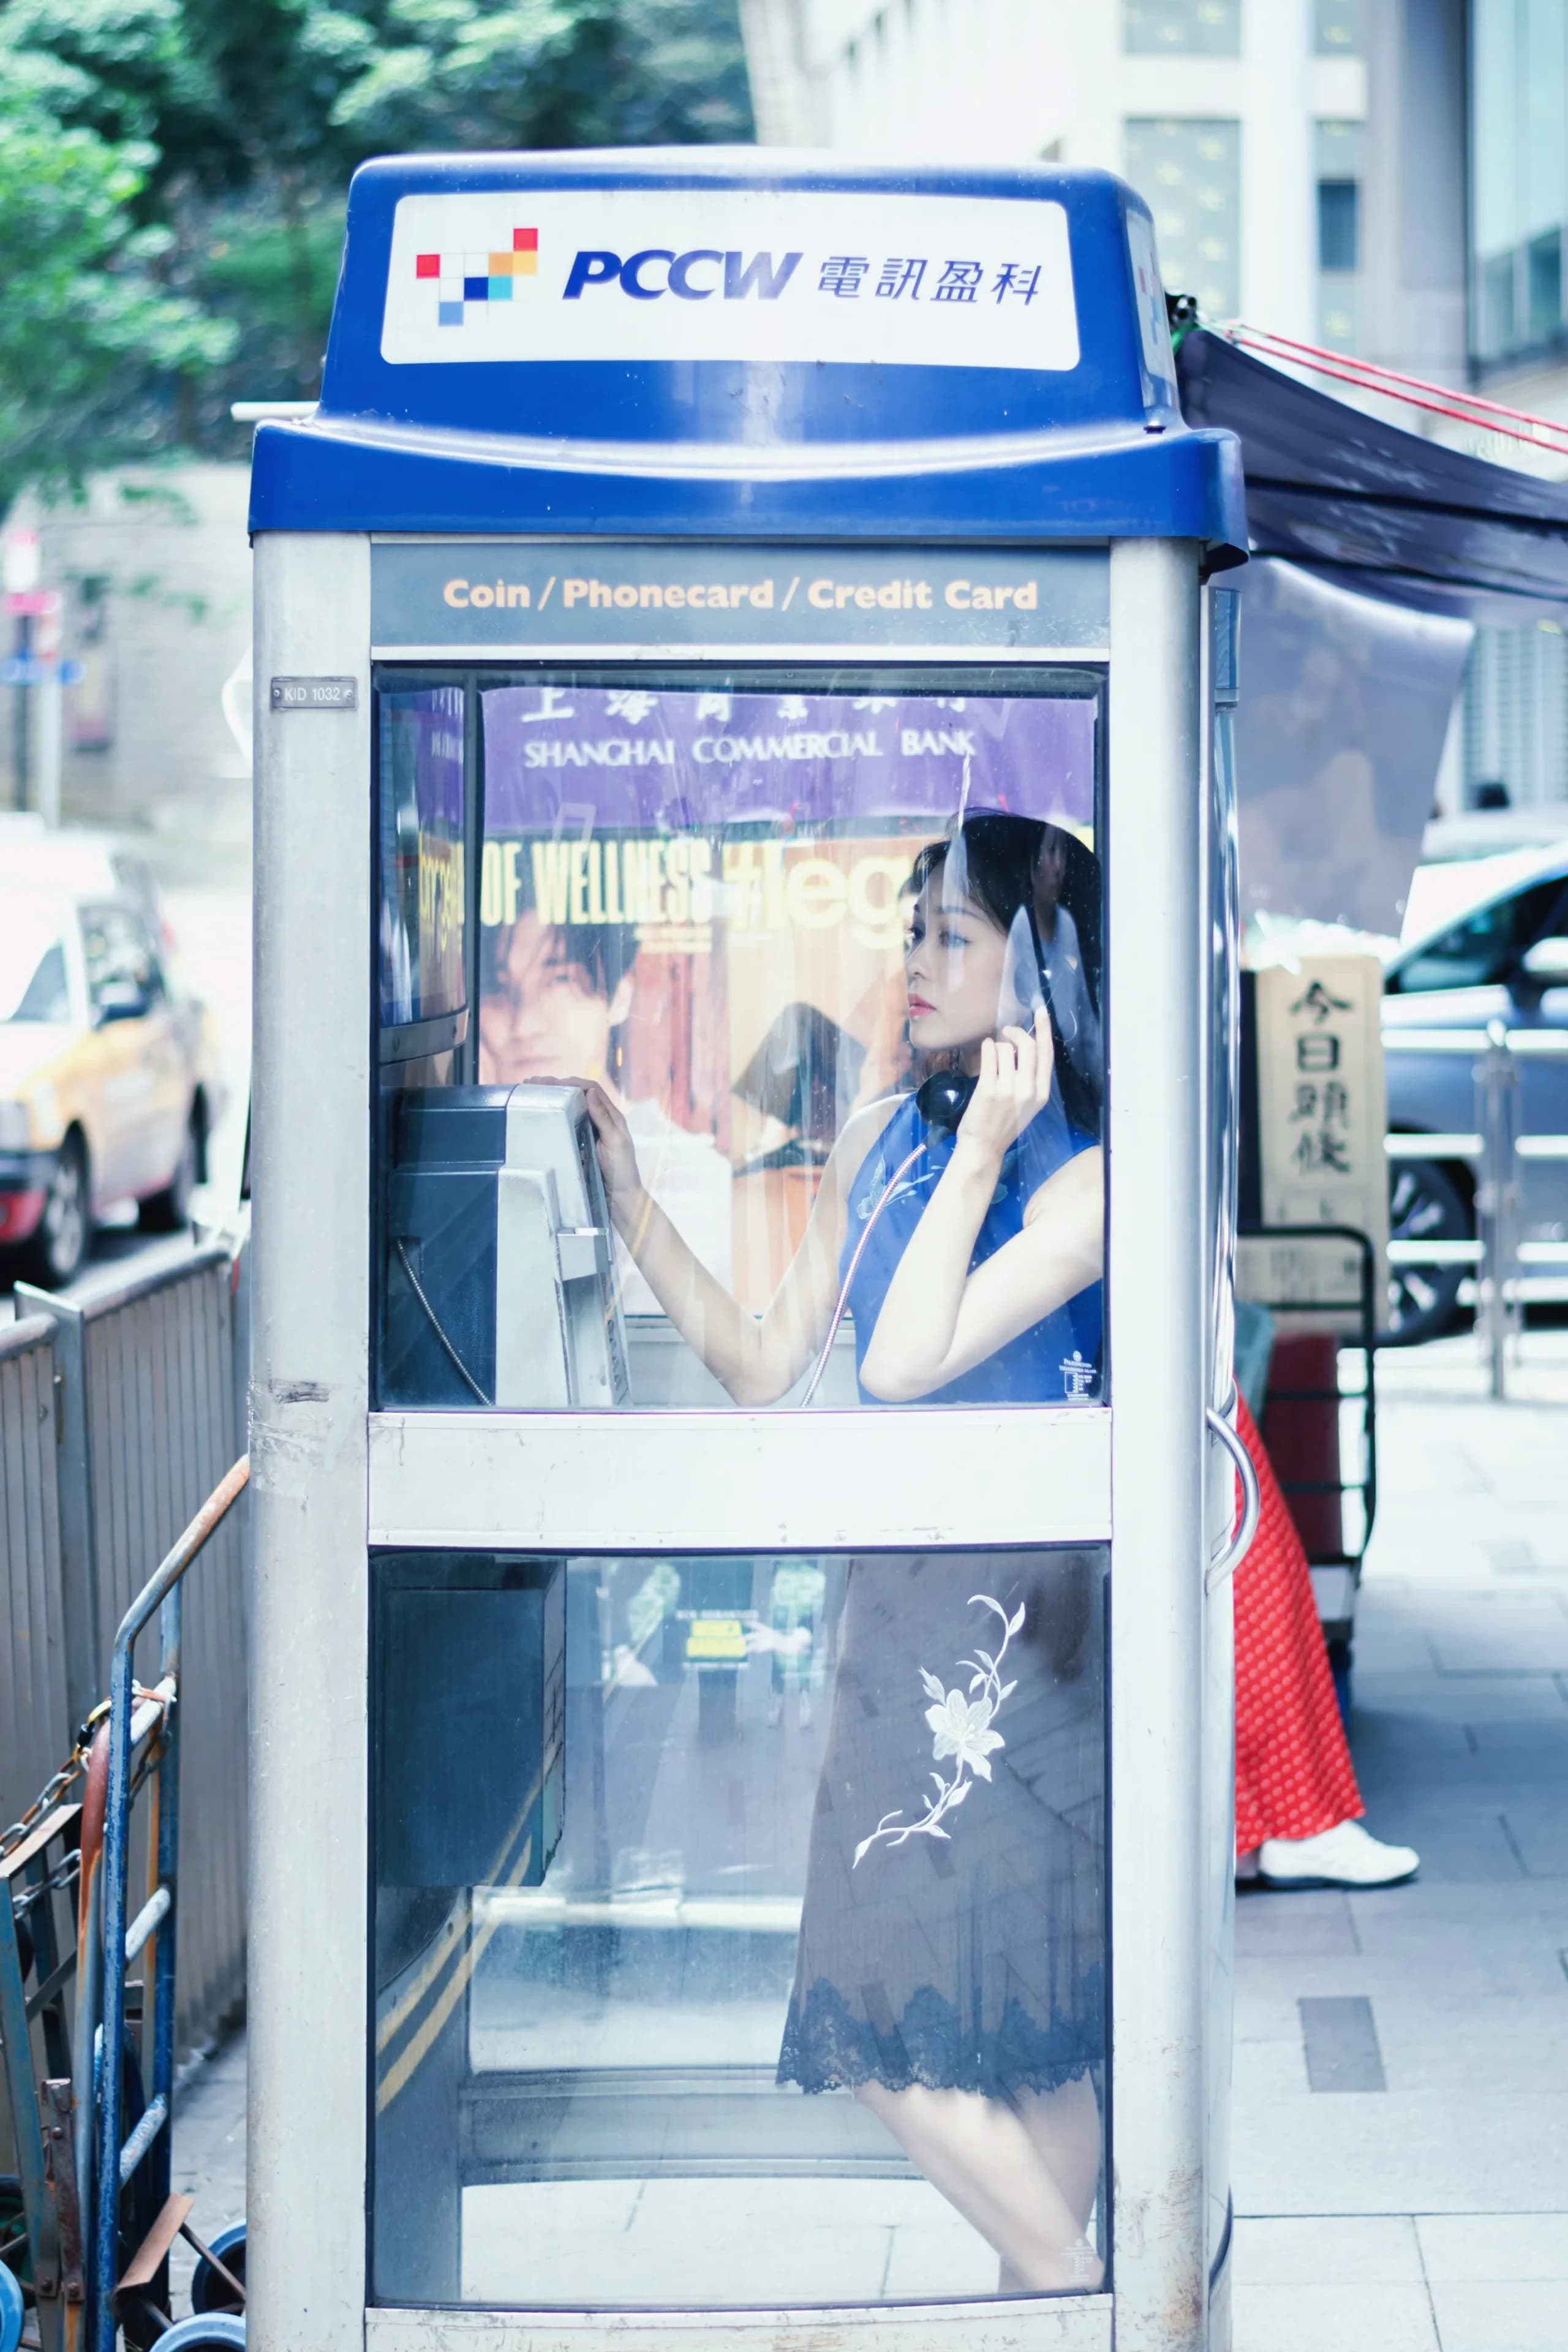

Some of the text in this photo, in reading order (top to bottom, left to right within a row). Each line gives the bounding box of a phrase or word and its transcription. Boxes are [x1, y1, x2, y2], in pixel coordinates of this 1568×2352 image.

[561, 249, 804, 301] PCCW
[818, 255, 1042, 306] 電訊盈科
[443, 579, 530, 608] Coin
[563, 579, 774, 609] Phonecard
[808, 580, 933, 609] Credit
[944, 580, 1038, 610] Card
[284, 687, 341, 701] KID 1032
[524, 728, 976, 769] SHANGHAI COMMERCIAL BANK
[481, 840, 522, 927] OF
[530, 838, 712, 925] WELLNESS
